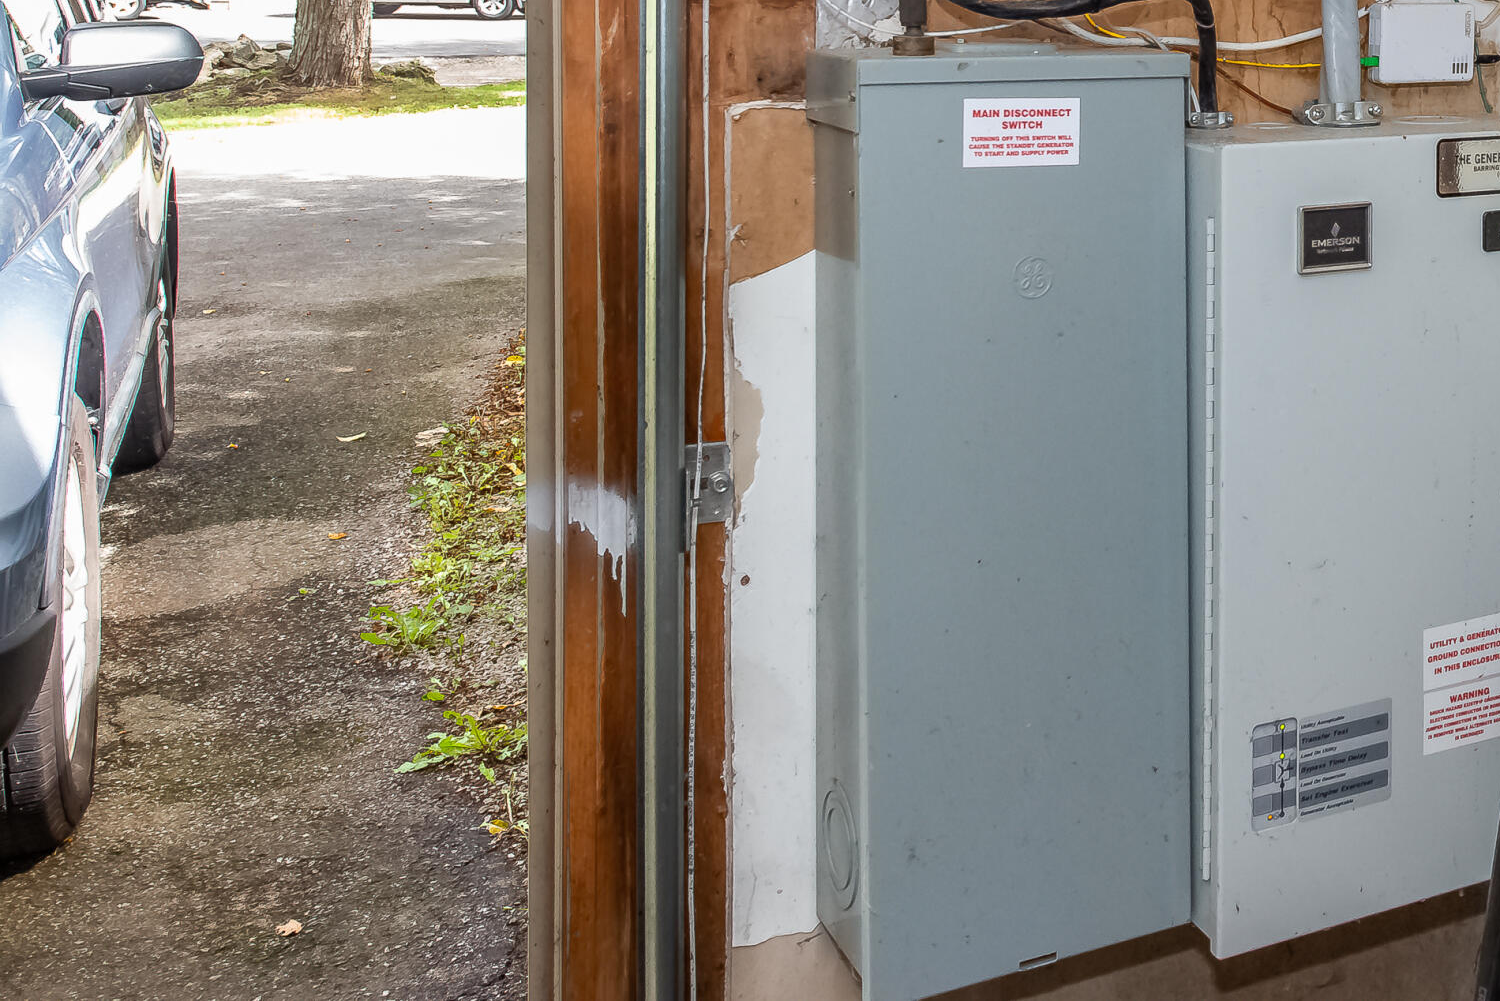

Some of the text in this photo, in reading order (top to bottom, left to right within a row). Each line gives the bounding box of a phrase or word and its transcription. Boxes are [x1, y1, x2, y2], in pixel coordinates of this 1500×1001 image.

[972, 108, 1072, 118] MAIN DISCONNECT
[1002, 121, 1043, 129] SWITCH
[1455, 154, 1472, 165] THE
[1311, 236, 1360, 248] EMERSON
[1429, 637, 1458, 650] UTILITY
[1459, 635, 1465, 643] &
[1427, 650, 1459, 663] GROUND
[1434, 667, 1442, 675] IN
[1443, 662, 1461, 672] THIS
[1449, 687, 1490, 703] WARNING
[1301, 729, 1349, 745] Transfer Test
[1300, 752, 1367, 774] Bypass Time Delay
[1315, 787, 1339, 799] Engine
